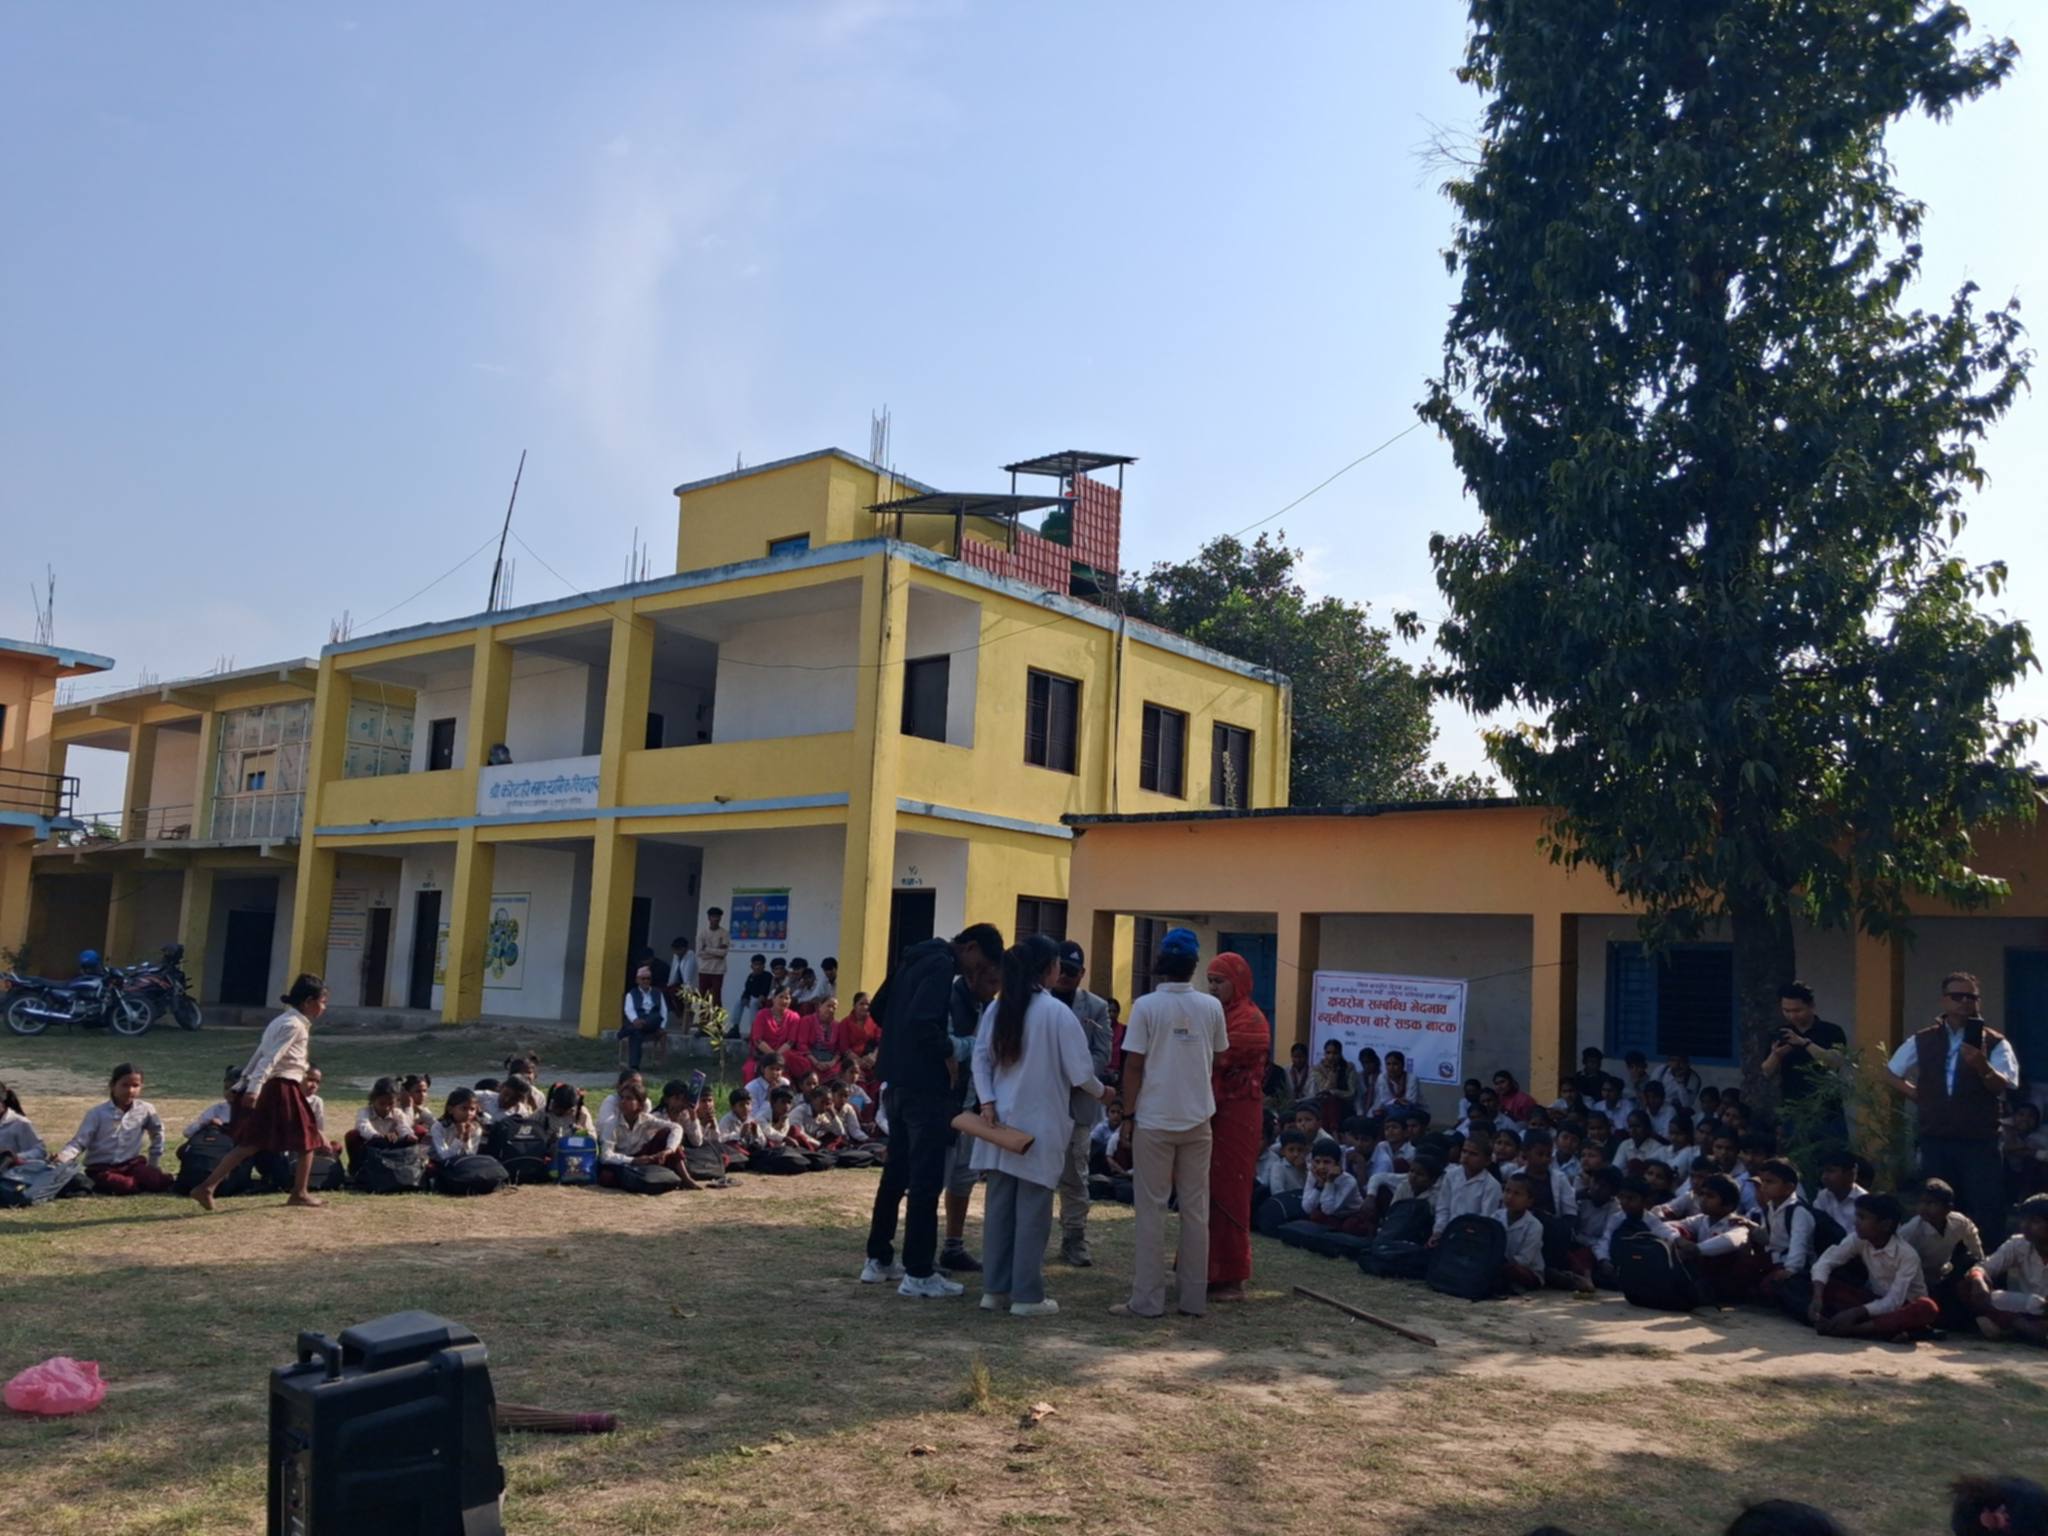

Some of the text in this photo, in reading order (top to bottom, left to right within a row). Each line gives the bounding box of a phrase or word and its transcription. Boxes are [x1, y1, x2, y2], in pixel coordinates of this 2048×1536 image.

[1328, 995, 1364, 1008] क्षयरोग
[1411, 999, 1447, 1014] भेदभाव
[1318, 1011, 1370, 1026] न्यूनीकरण
[1394, 1018, 1422, 1030] सडक
[1426, 1021, 1456, 1032] नाटक
